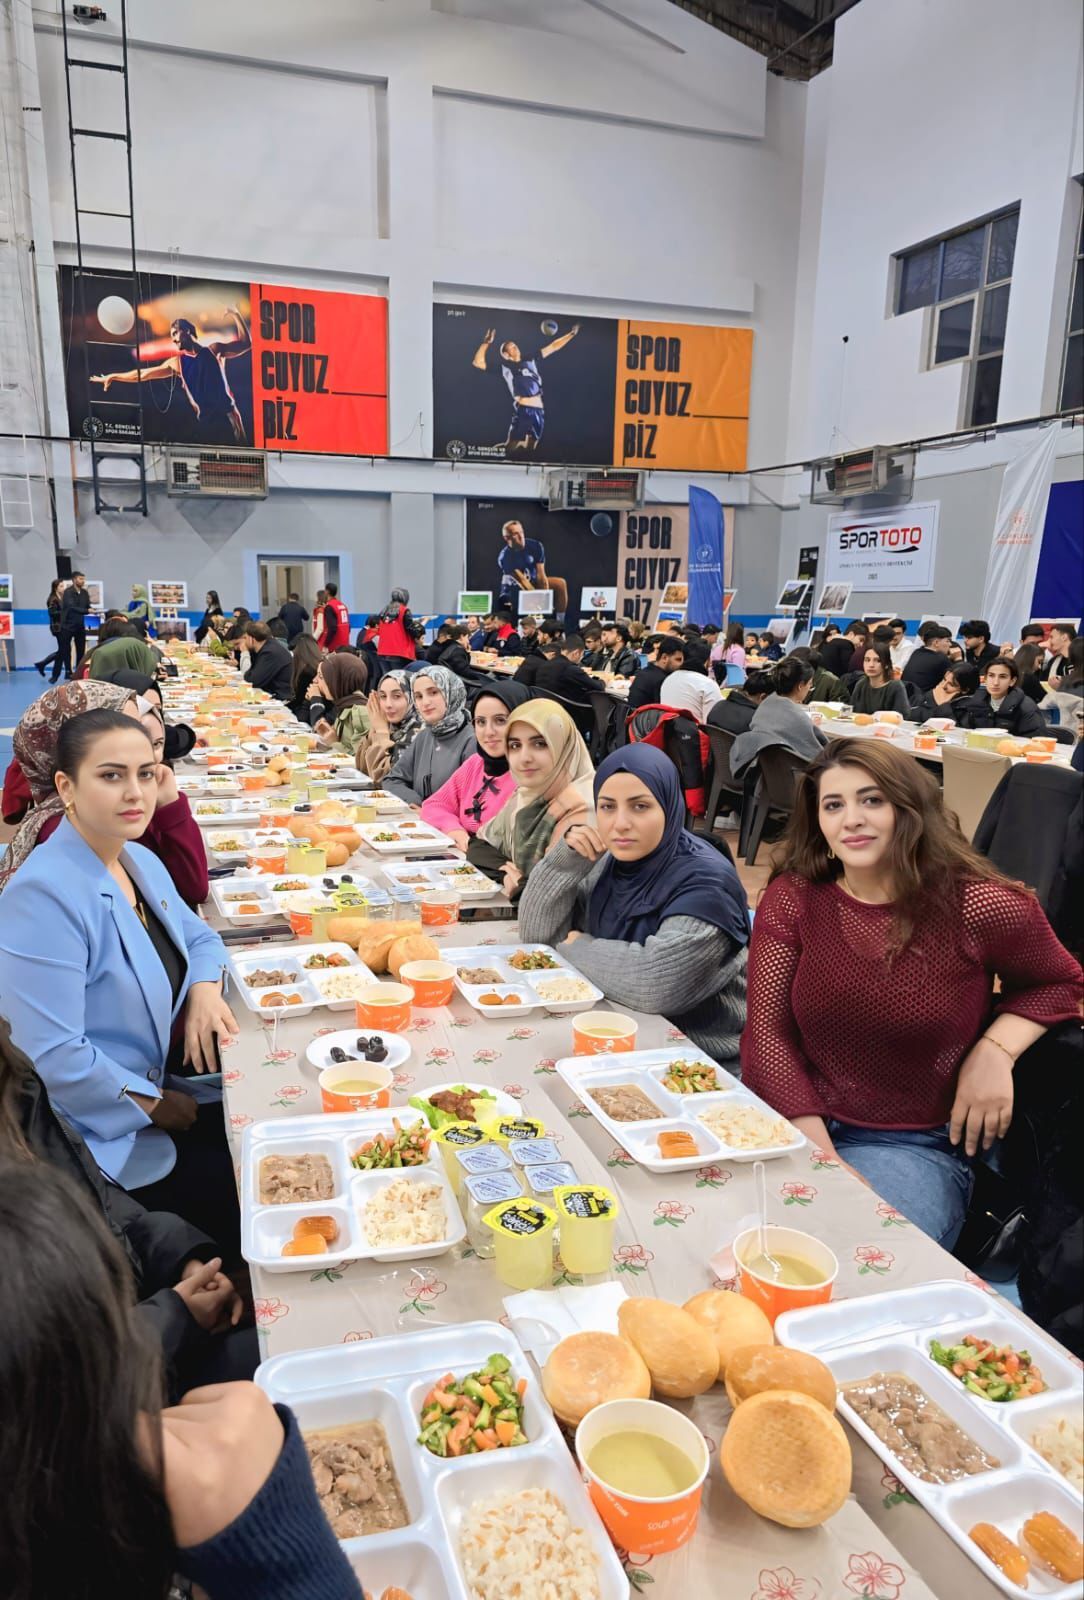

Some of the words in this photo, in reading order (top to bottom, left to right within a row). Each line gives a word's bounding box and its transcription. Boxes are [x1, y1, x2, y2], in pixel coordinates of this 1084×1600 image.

[260, 299, 316, 344] SPOR
[261, 350, 329, 394] CUYUZ
[626, 334, 681, 373] SPOR
[624, 379, 692, 417] CUYUZ
[262, 396, 298, 440] BİZ
[623, 419, 657, 459] BİZ
[626, 516, 672, 549] SPOR
[624, 557, 681, 590] CUYUZ
